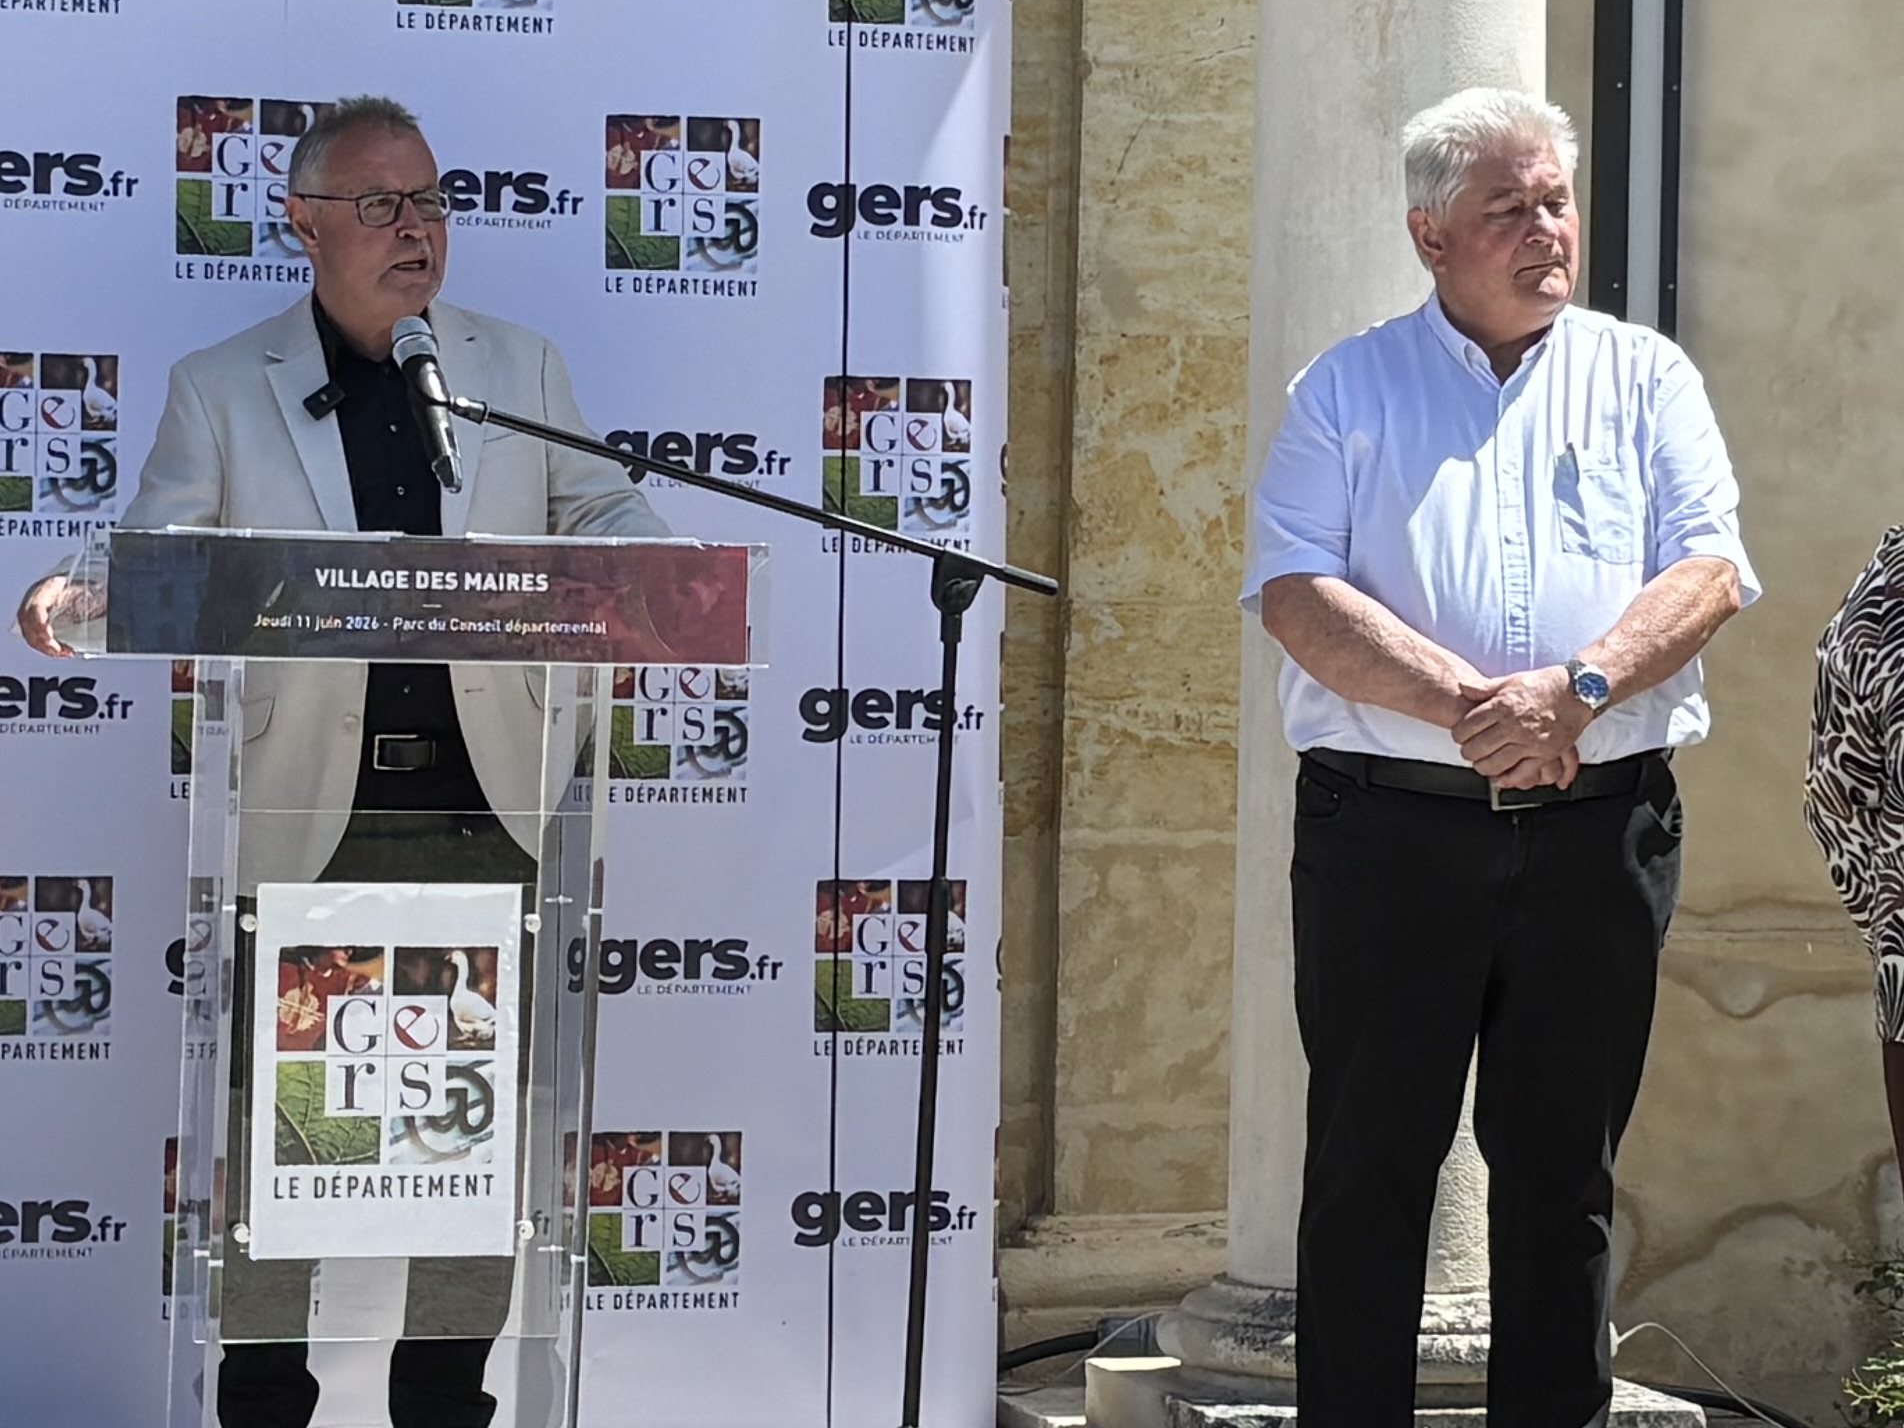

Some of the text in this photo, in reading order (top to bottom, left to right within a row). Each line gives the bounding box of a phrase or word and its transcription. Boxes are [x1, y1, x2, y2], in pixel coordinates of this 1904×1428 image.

[397, 10, 553, 34] LE DÉPARTEMENT
[828, 28, 974, 53] LE DÉPARTEMENT
[438, 169, 584, 214] ers.fr
[807, 181, 988, 238] gers.fr
[176, 261, 311, 283] LE DÉPARTEME
[606, 276, 757, 297] LE DÉPARTEMENT
[822, 537, 838, 553] LE
[315, 568, 549, 592] VILLAGE DES MAIRES
[254, 614, 292, 629] Jeudi
[297, 616, 311, 628] 11
[315, 615, 342, 632] juin
[347, 616, 379, 630] 2026
[393, 617, 424, 631] Parc
[428, 617, 445, 630] du
[450, 618, 501, 633] Conseil
[505, 619, 607, 635] départemental
[609, 787, 617, 803] E
[625, 783, 747, 803] DÉPARTEMENT
[814, 1036, 965, 1056] LE DÉPARTEENT
[274, 1171, 494, 1199] LE DÉPARTEMENT
[587, 1293, 604, 1310] LE
[614, 1289, 739, 1310] DÉPARTEMENT
